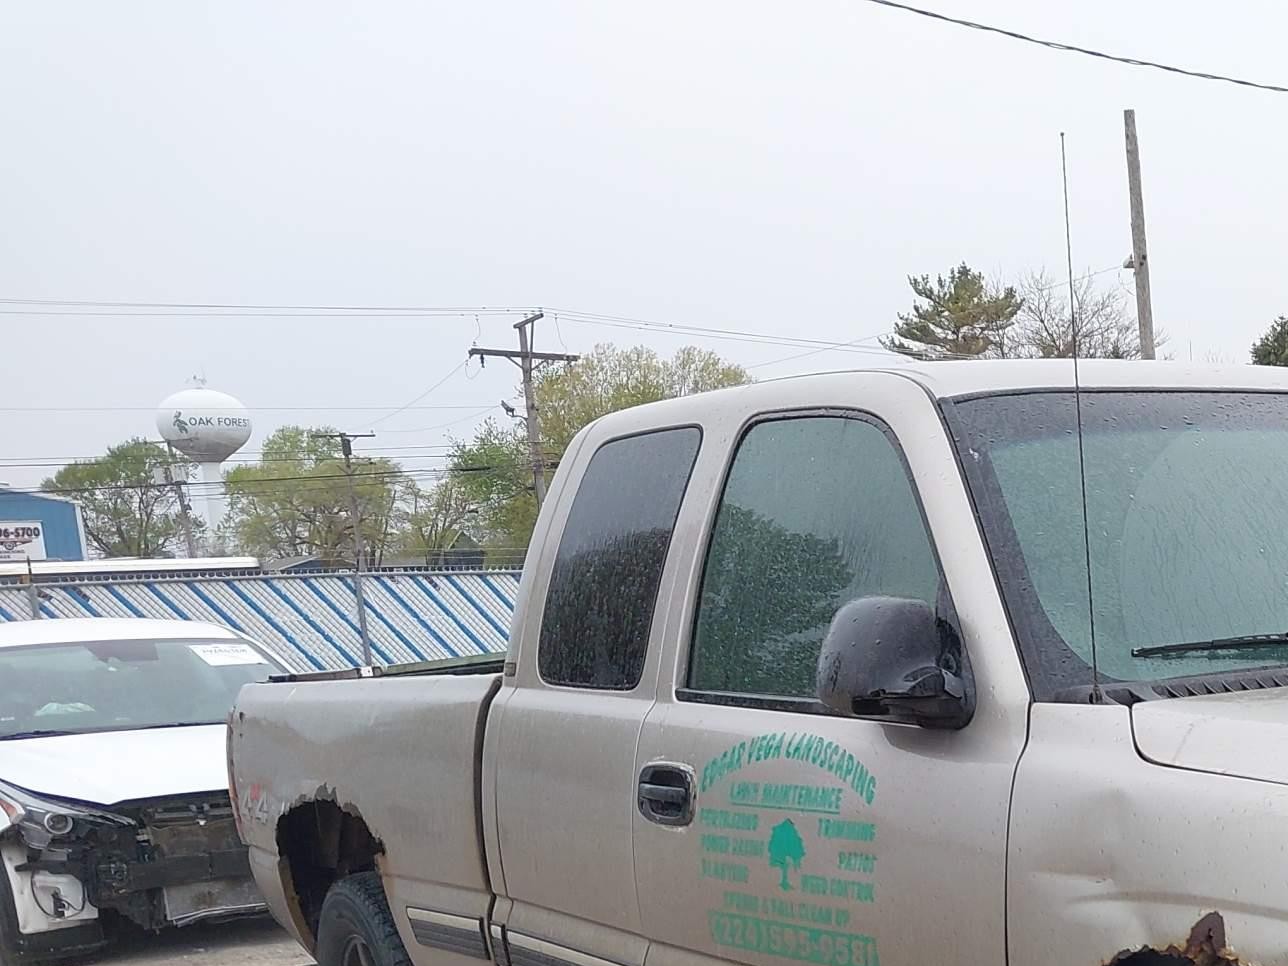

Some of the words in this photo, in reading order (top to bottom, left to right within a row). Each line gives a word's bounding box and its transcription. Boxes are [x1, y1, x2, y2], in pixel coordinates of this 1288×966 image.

[188, 416, 214, 427] OAK
[748, 732, 786, 764] VEGA
[785, 732, 877, 806] LANDSCAPING
